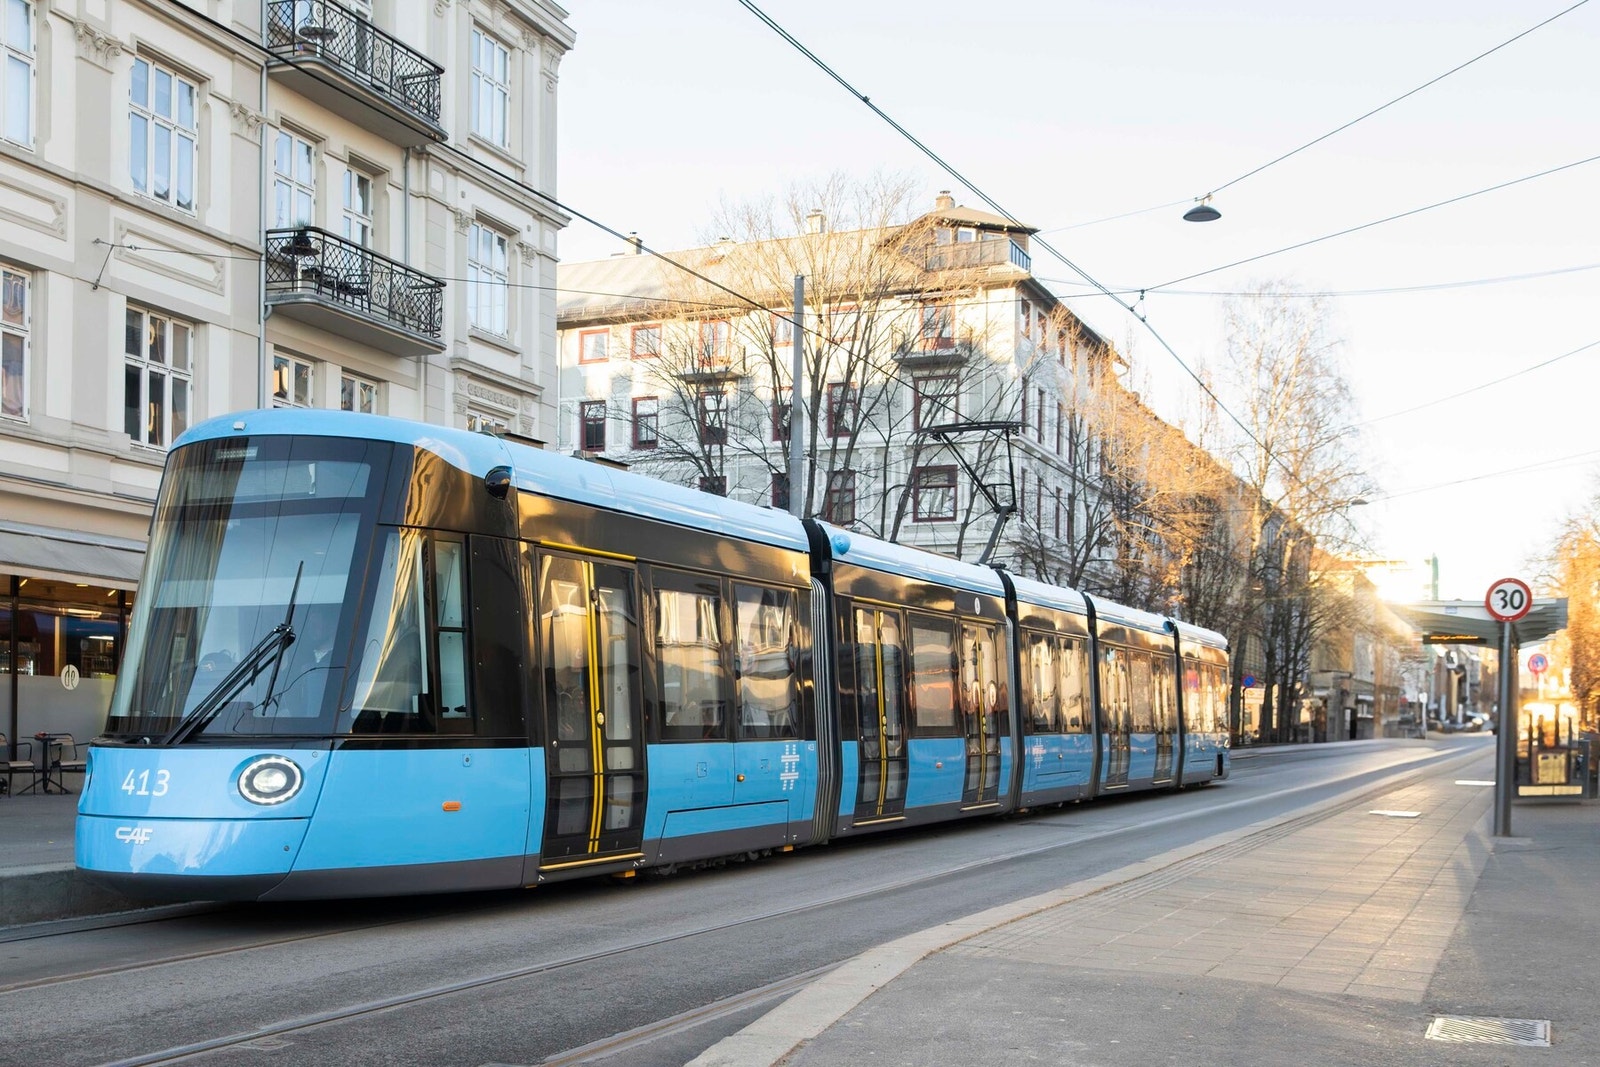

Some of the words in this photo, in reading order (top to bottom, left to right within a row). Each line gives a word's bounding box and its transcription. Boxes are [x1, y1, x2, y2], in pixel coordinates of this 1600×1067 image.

[1495, 588, 1524, 610] 30
[121, 768, 171, 797] 413
[115, 826, 153, 845] CAF
